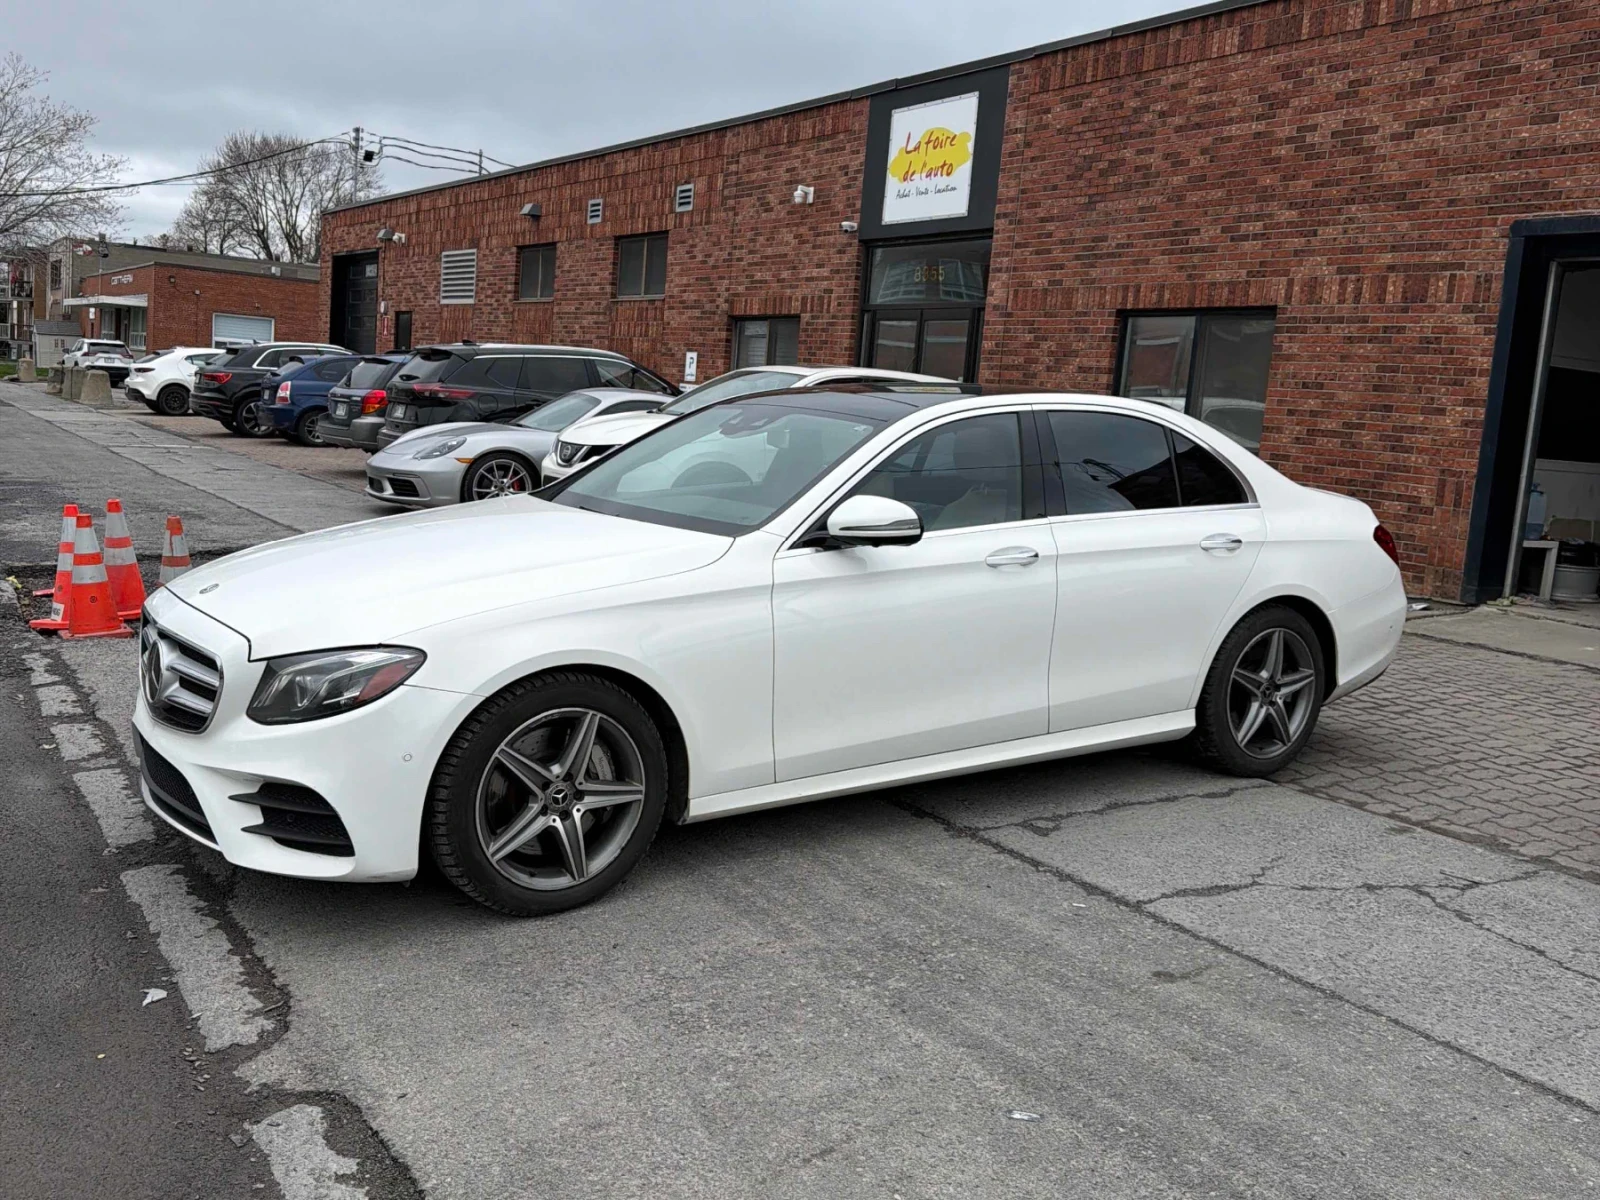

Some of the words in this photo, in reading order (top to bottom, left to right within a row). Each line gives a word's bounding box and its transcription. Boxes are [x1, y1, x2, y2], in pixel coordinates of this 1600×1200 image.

[905, 131, 921, 154] La
[924, 130, 957, 157] foire
[903, 160, 916, 183] de
[920, 159, 953, 181] l'auto
[895, 188, 911, 199] Achat
[915, 185, 929, 197] Vente
[934, 183, 957, 195] Location
